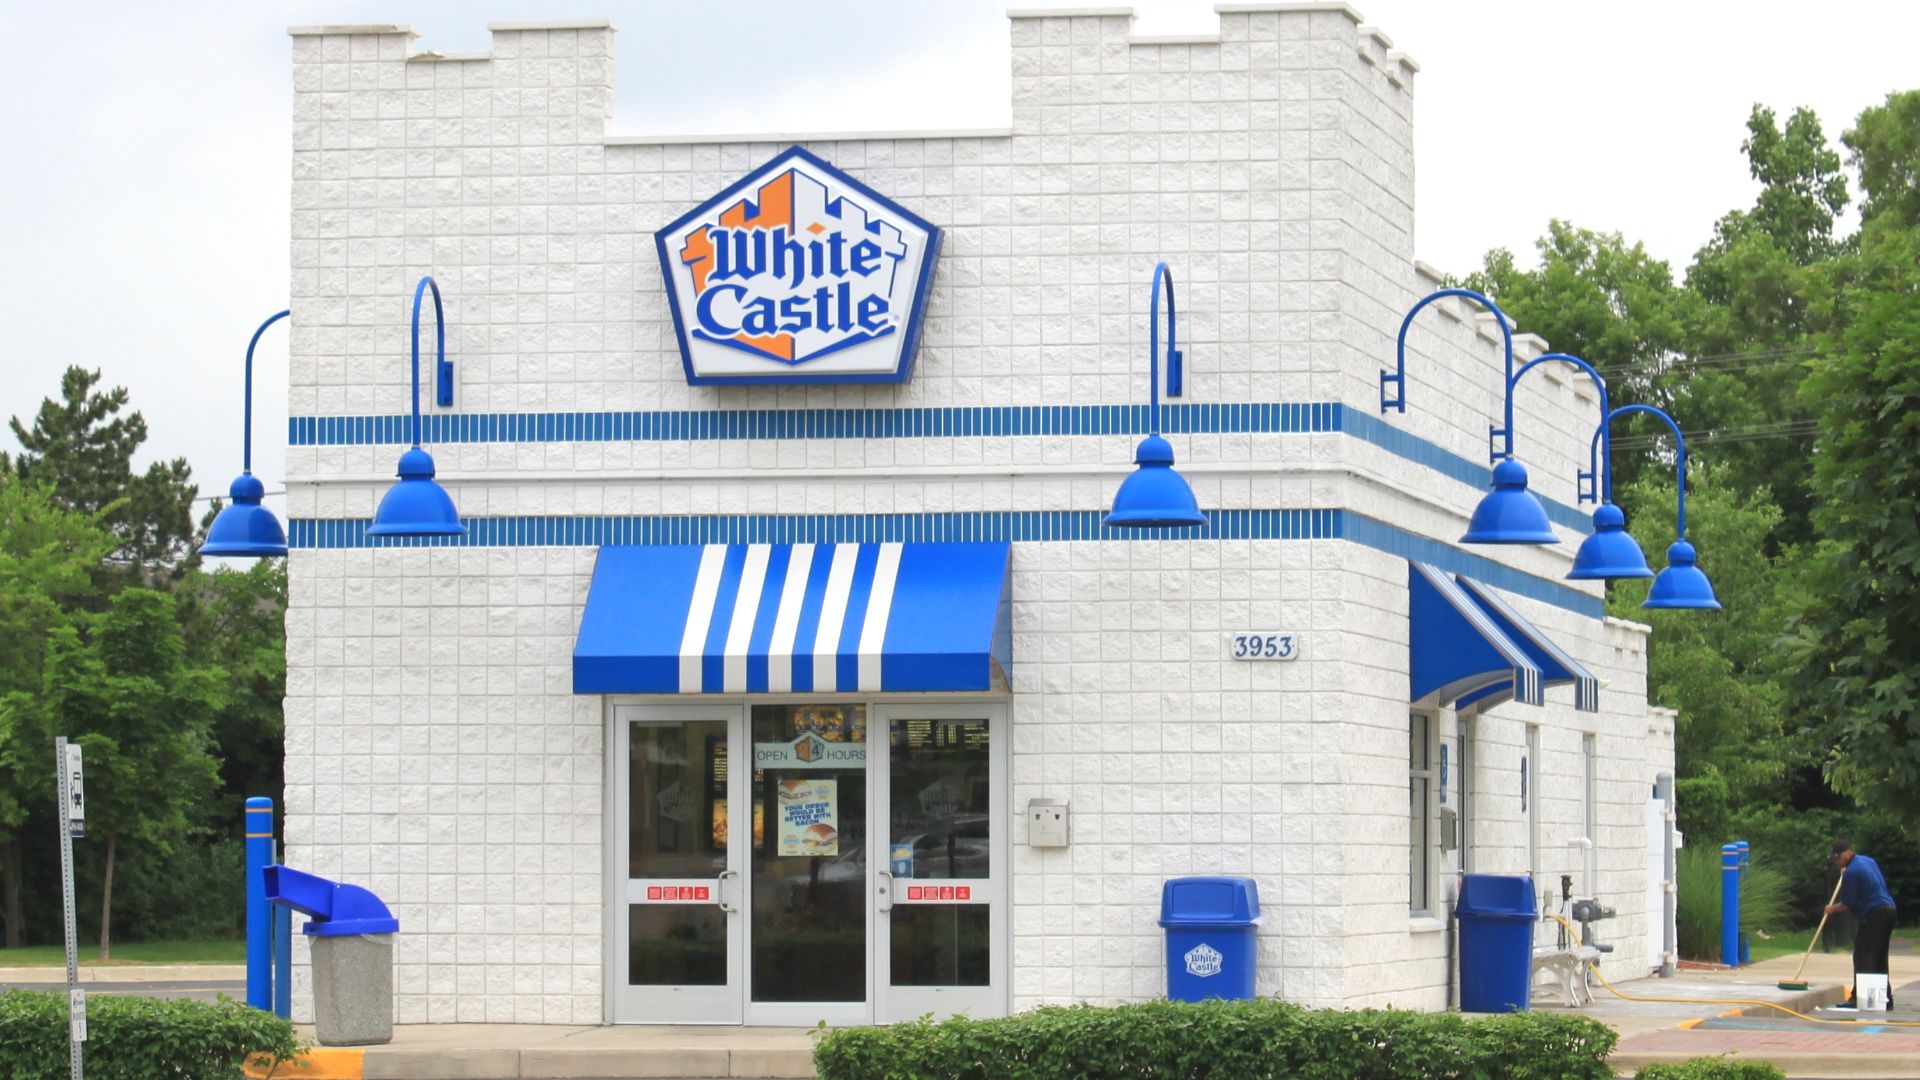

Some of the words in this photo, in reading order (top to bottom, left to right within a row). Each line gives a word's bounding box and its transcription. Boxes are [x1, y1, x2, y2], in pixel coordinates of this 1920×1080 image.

[706, 226, 882, 290] White
[696, 281, 889, 336] Castle
[1235, 635, 1292, 657] 3953
[757, 750, 788, 760] OPEN
[827, 750, 866, 760] HOURS
[785, 804, 803, 812] YOUR
[1191, 954, 1217, 963] White
[1189, 963, 1218, 971] Castle
